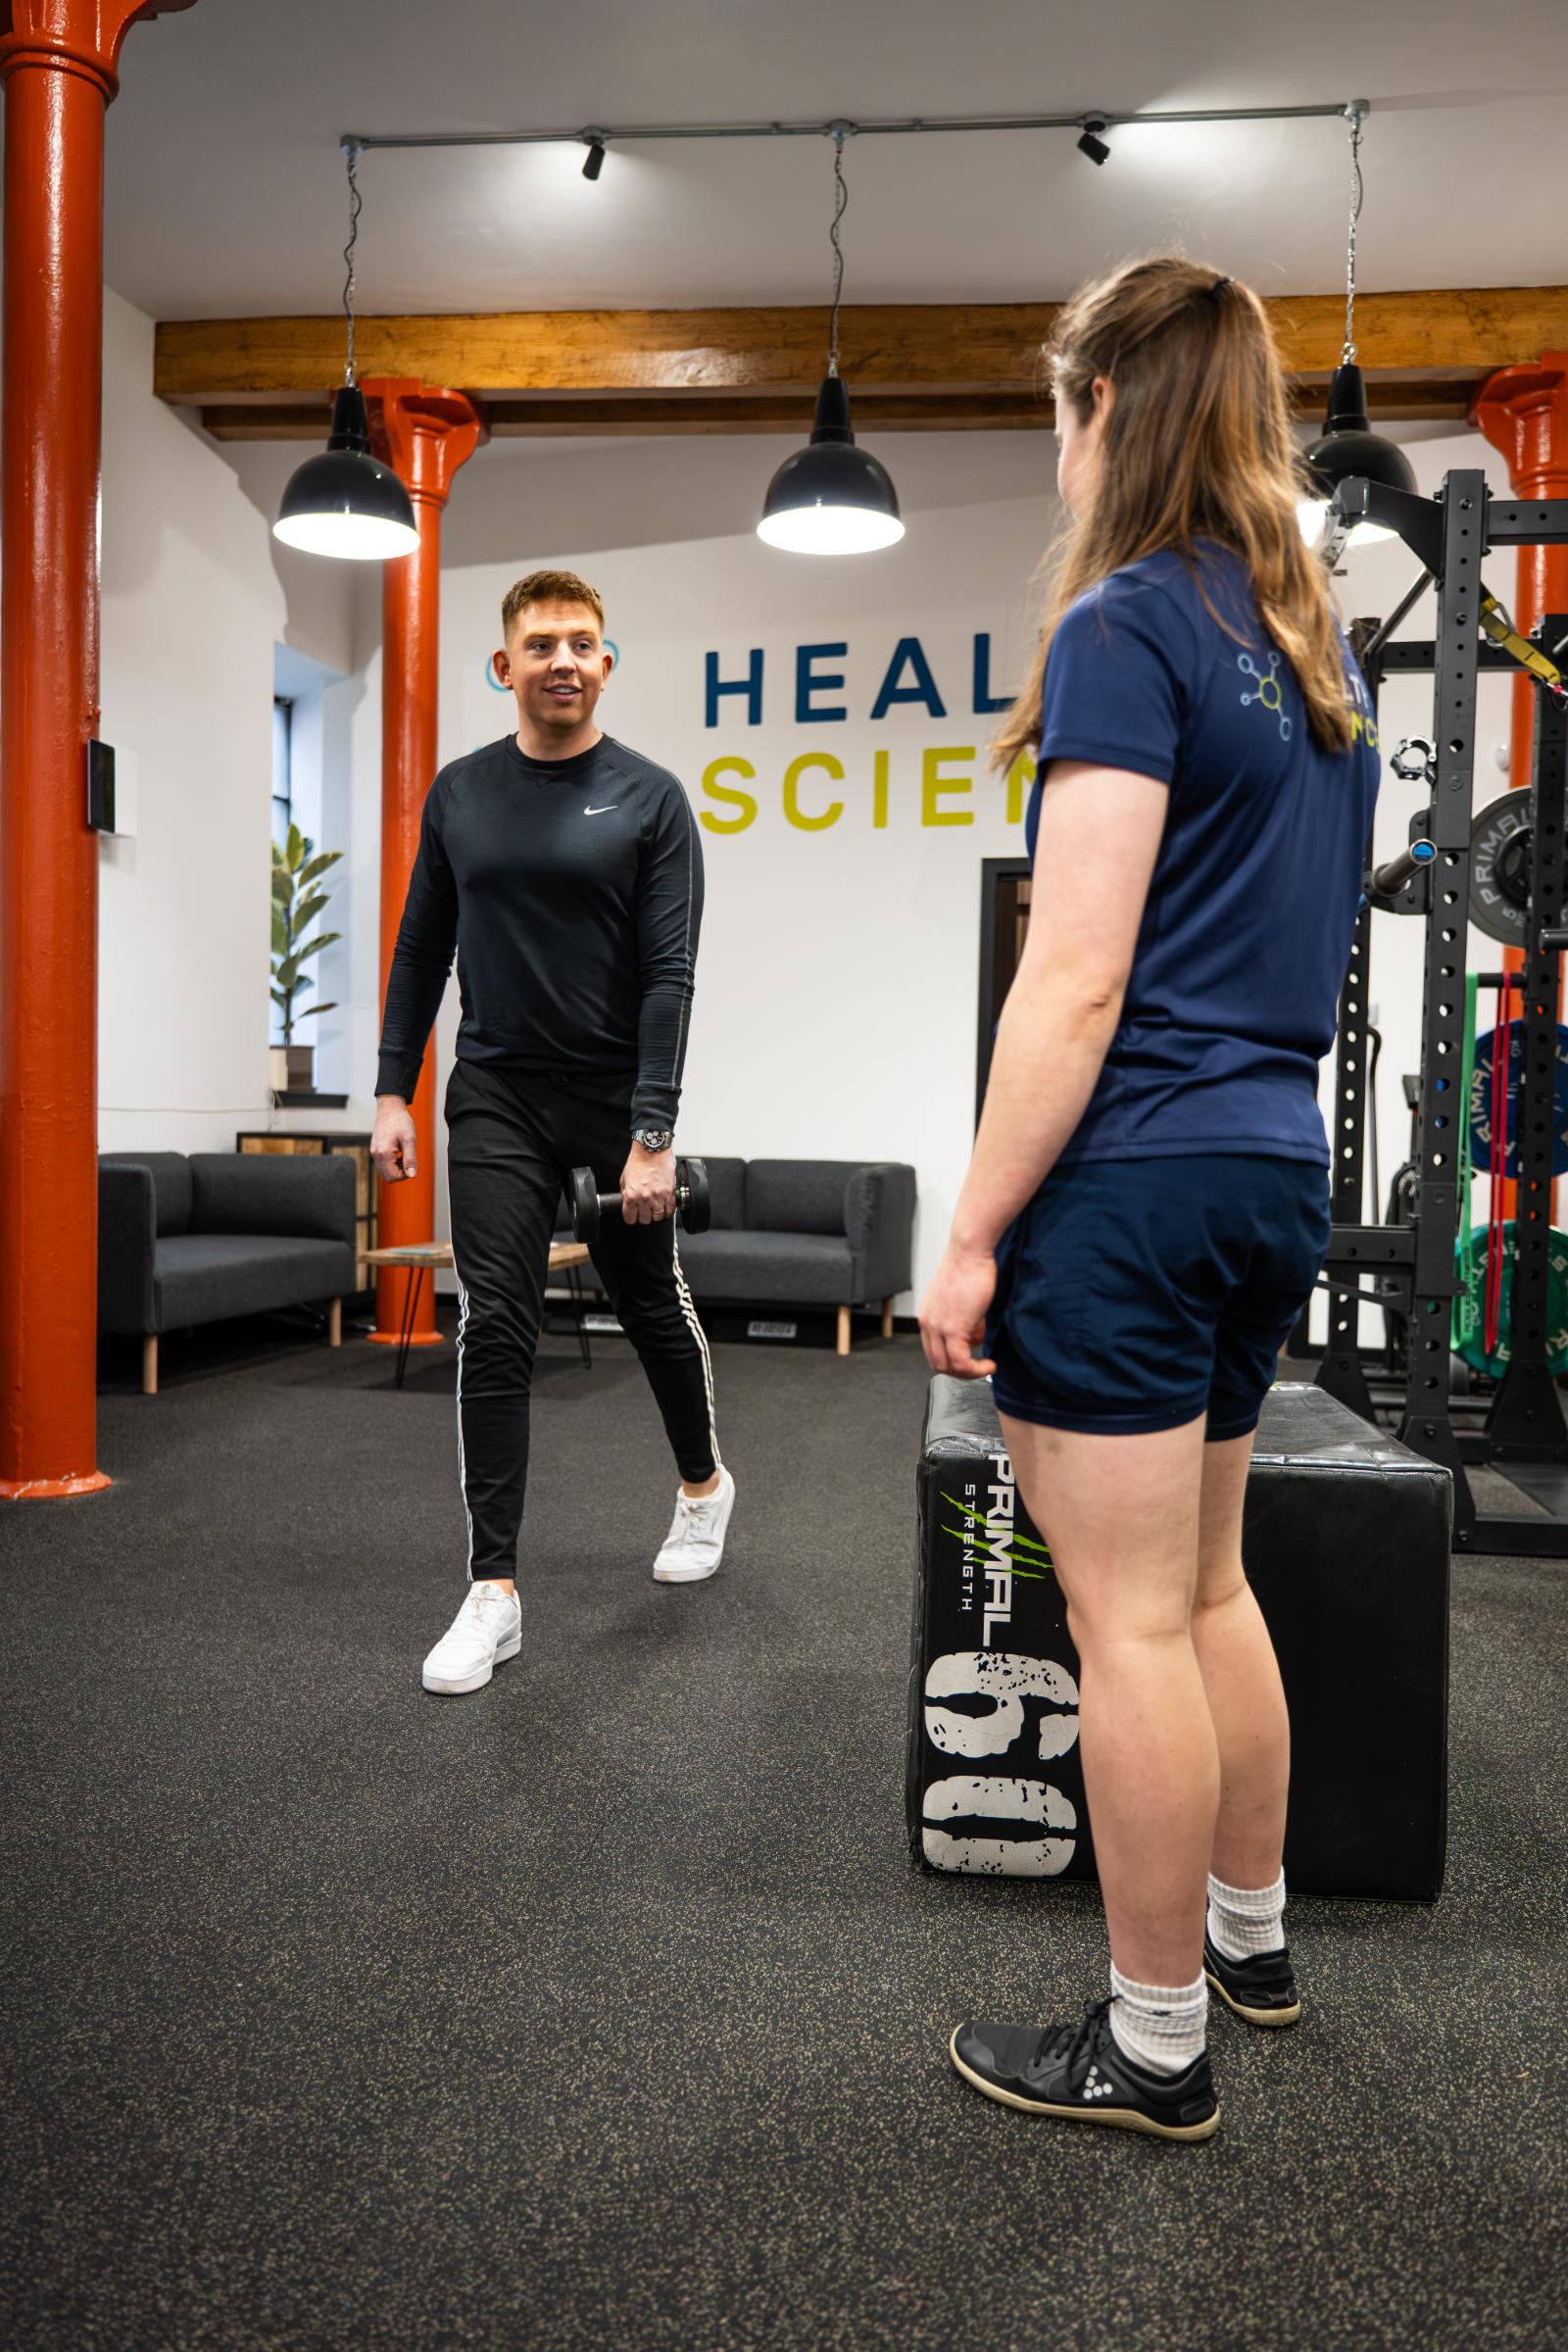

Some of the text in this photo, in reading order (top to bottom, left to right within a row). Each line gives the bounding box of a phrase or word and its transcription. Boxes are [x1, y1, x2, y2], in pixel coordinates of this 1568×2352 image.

[705, 633, 1019, 728] HEAL
[961, 1484, 976, 1610] STRENGTH
[983, 1454, 1015, 1647] PRIMAL
[921, 1651, 1080, 1877] 60
